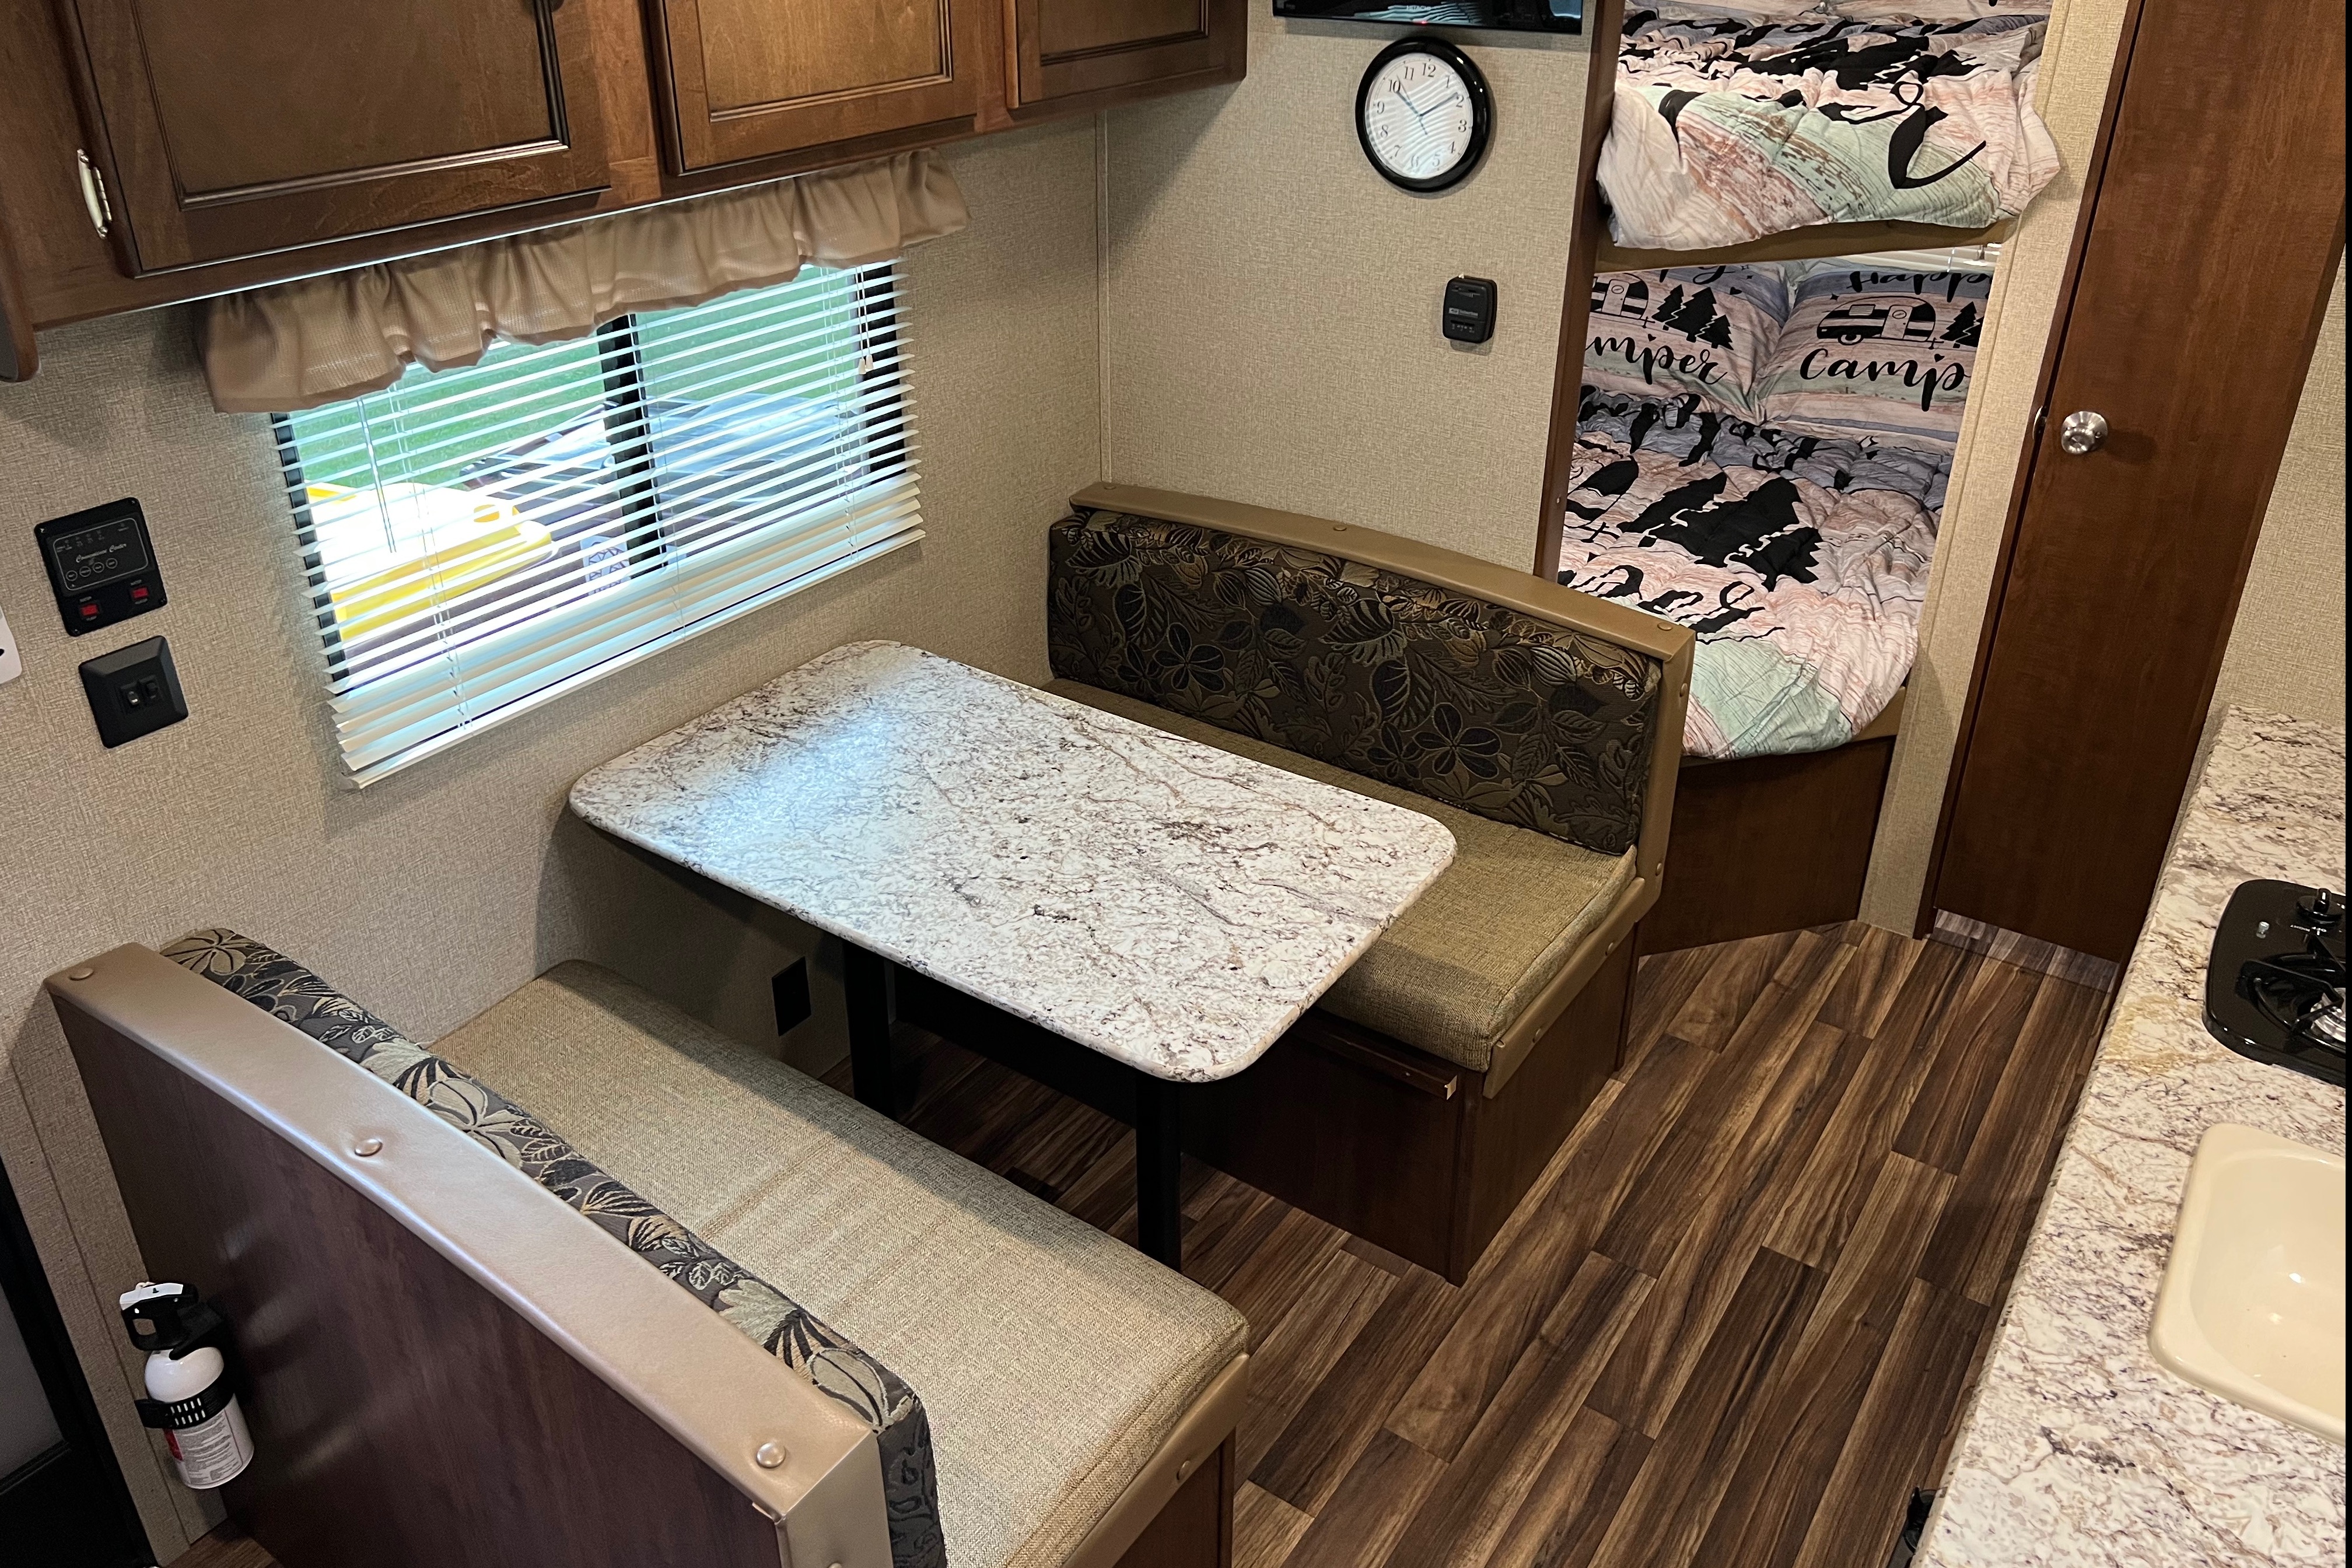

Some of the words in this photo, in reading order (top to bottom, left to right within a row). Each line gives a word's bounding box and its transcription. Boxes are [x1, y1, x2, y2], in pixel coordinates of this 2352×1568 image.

[1404, 66, 1415, 81] 11
[1422, 62, 1436, 78] 12
[1388, 79, 1401, 93] 10
[1445, 75, 1451, 89] 1
[1377, 101, 1385, 114] 9
[1455, 94, 1465, 108] 2
[1380, 124, 1388, 138] 8
[1458, 119, 1467, 133] 3
[1393, 145, 1402, 158] 7
[1448, 141, 1457, 155] 4
[1432, 149, 1441, 167] 5
[1846, 271, 1993, 303] Happ
